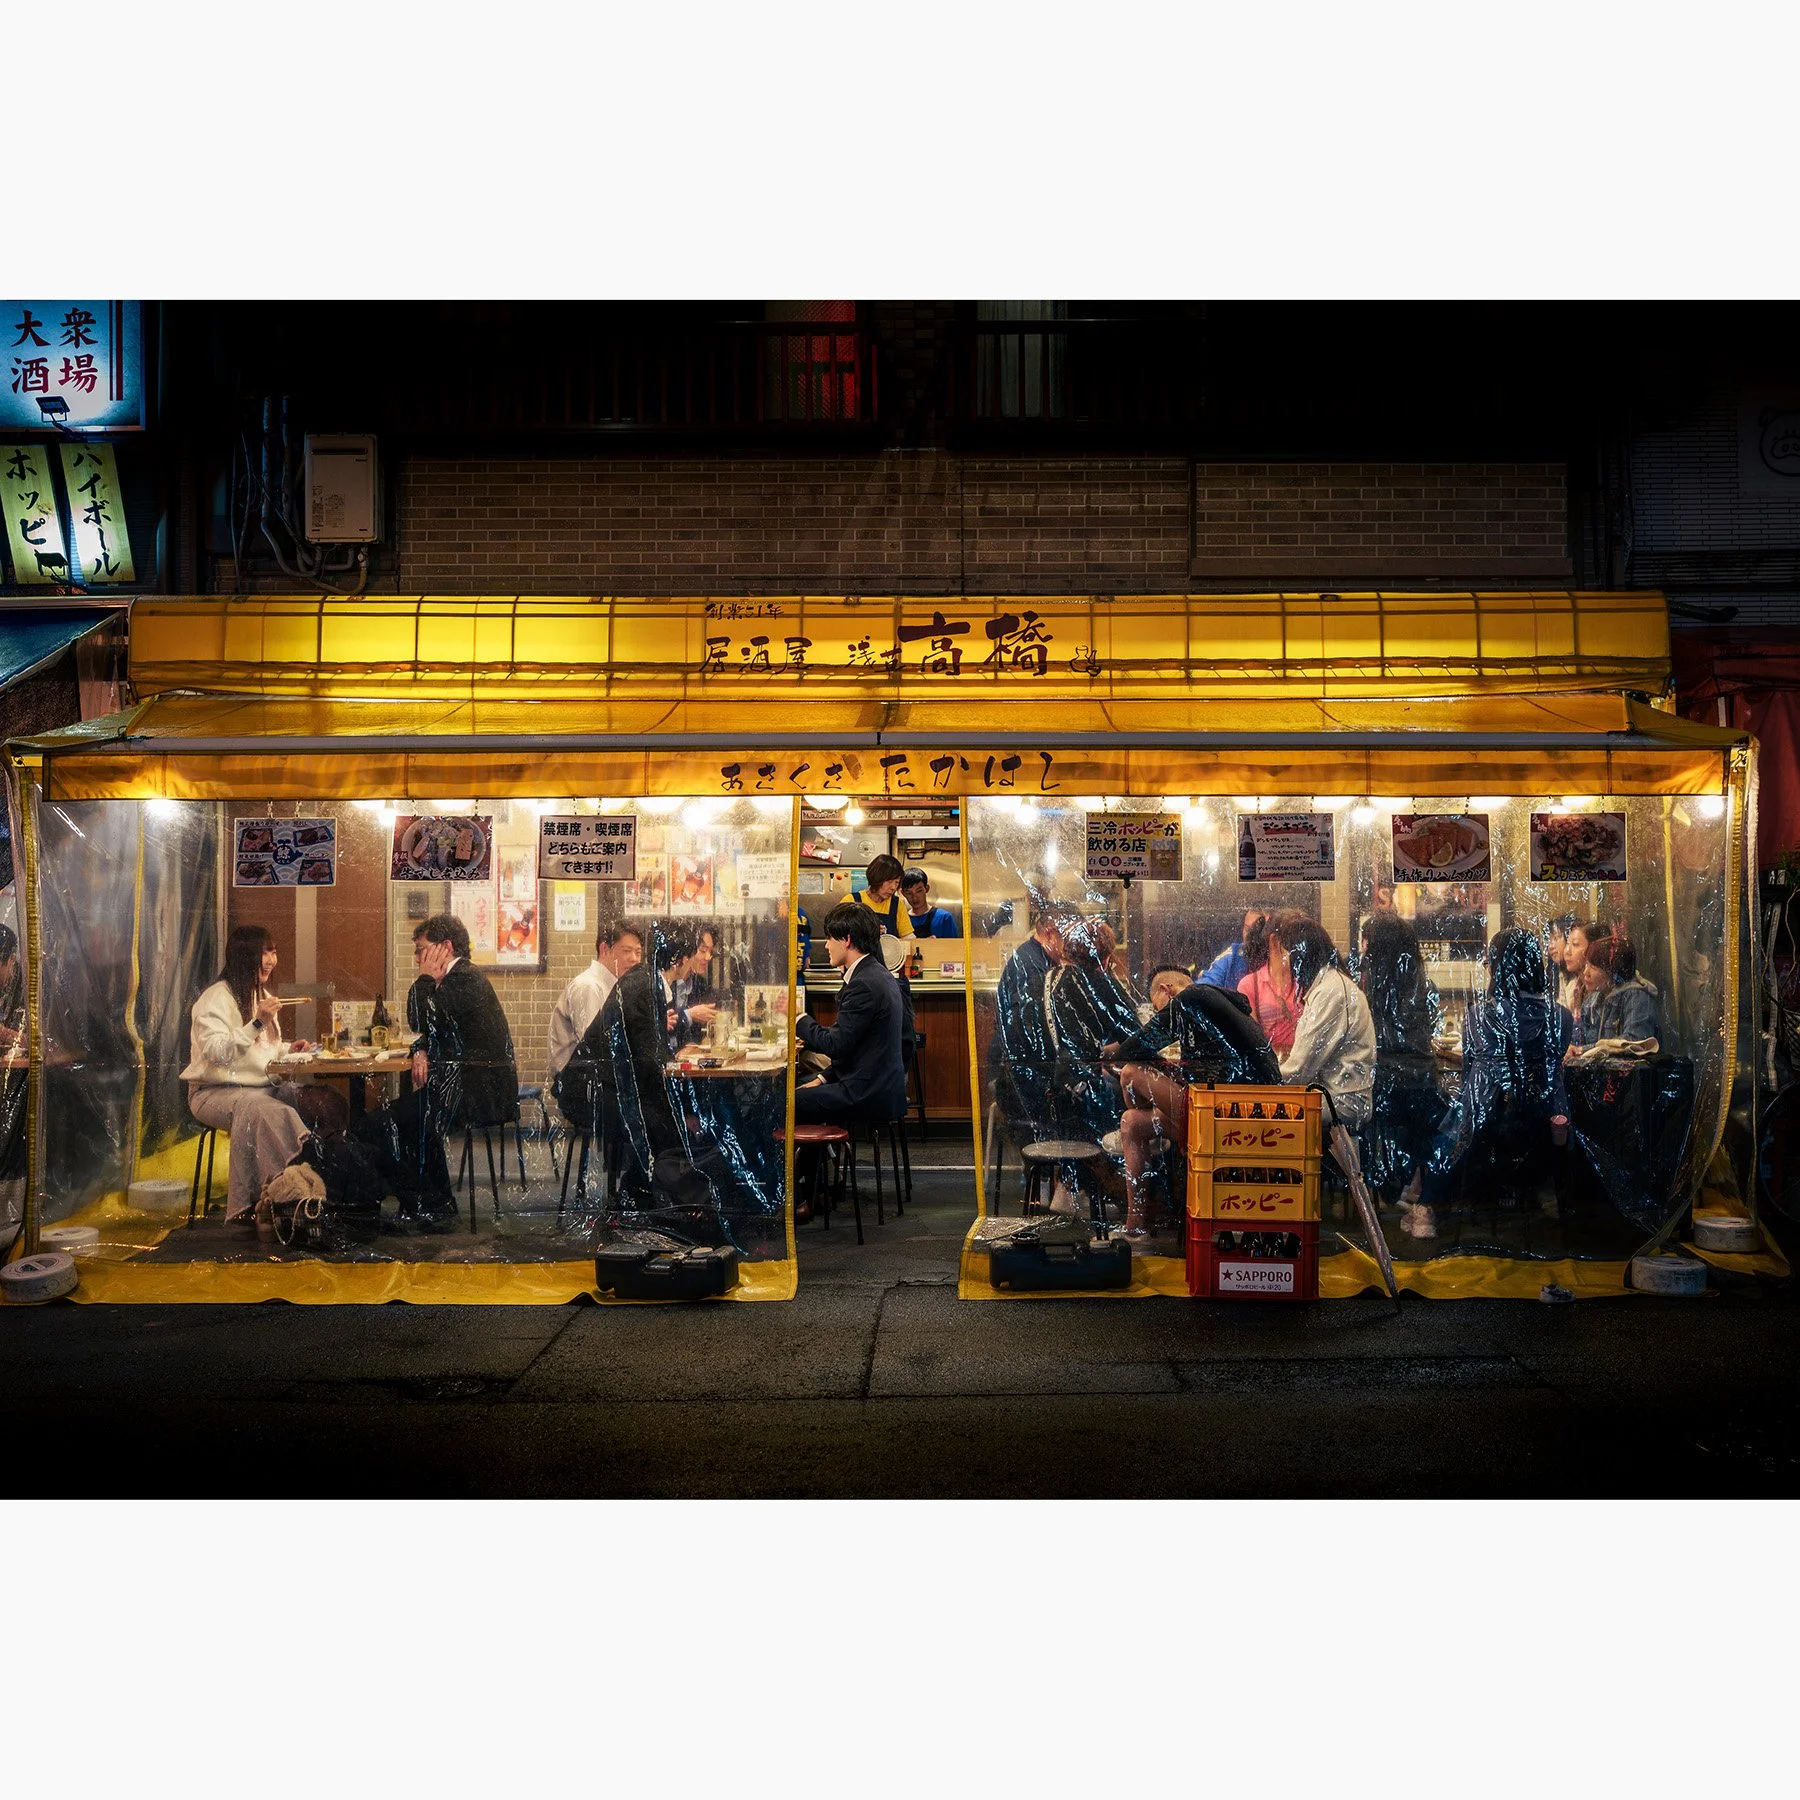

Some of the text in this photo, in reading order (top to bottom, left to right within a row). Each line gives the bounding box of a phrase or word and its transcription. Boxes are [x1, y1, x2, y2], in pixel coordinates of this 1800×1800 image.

[11, 307, 98, 349] 大衆
[11, 354, 98, 393] 酒場
[73, 452, 120, 577] ハイボール
[699, 635, 814, 675] 居酒屋
[897, 610, 1053, 677] 高橋
[721, 752, 1060, 791] あさくさ たかはし
[543, 821, 632, 836] 禁煙席・喫煙席
[1088, 819, 1179, 836] 三冷ホッピーが
[548, 842, 627, 855] どちらもご案内
[1087, 837, 1146, 852] 飲める店
[562, 861, 613, 874] できます!!
[1397, 868, 1488, 881] 手作りハムカツ
[1222, 1128, 1295, 1147] ホッピー
[1220, 1192, 1294, 1212] ホッピー
[1236, 1269, 1292, 1282] SAPPORO
